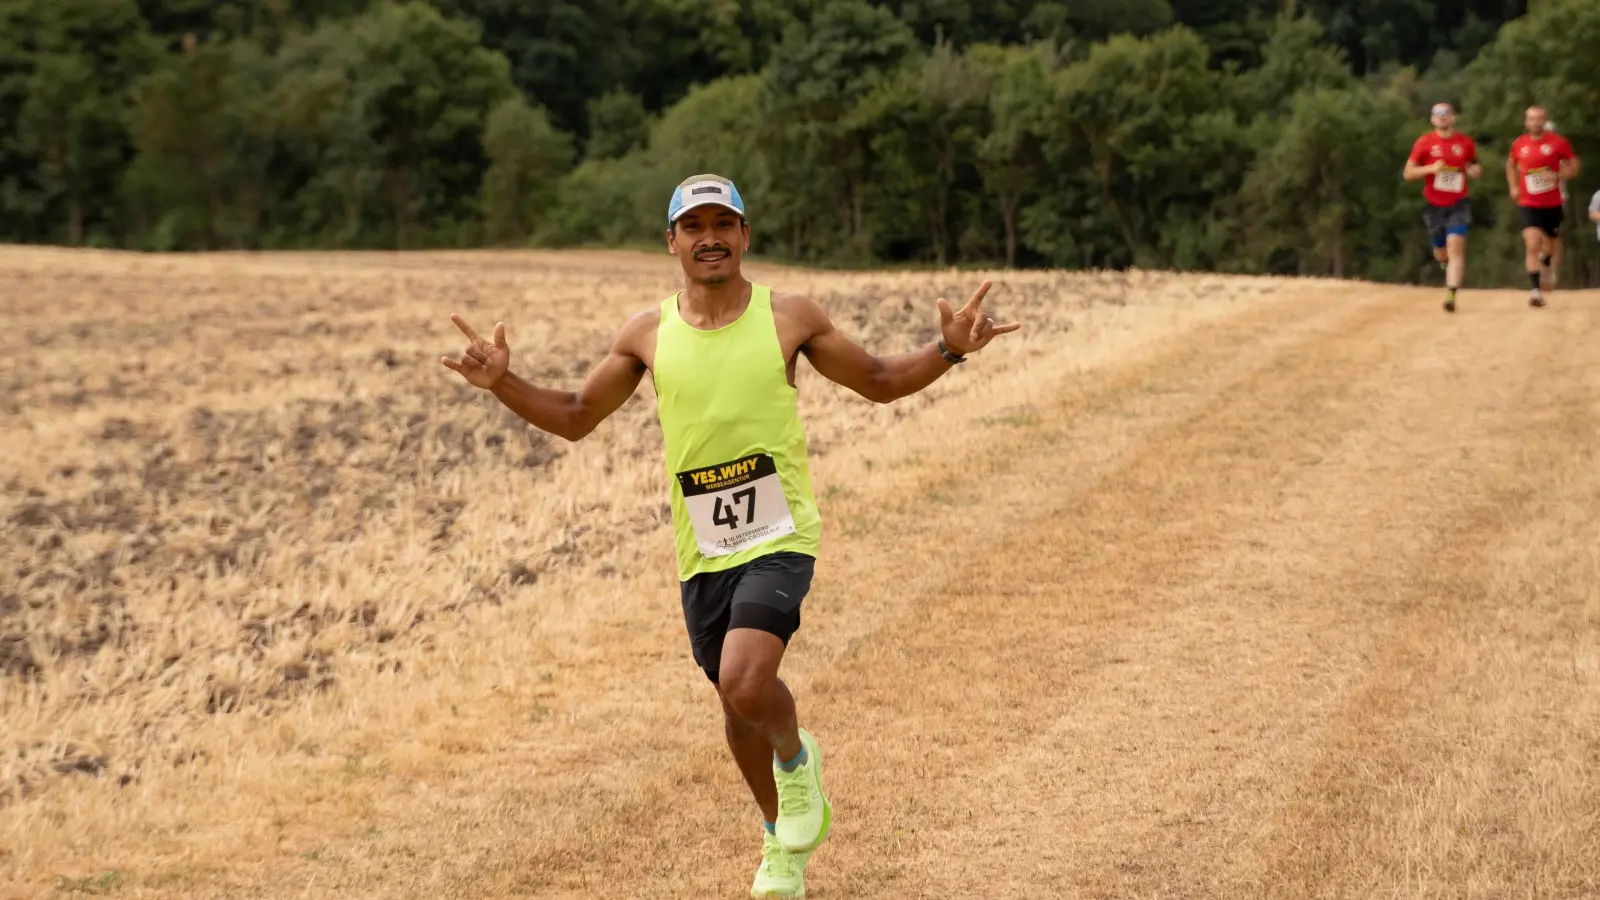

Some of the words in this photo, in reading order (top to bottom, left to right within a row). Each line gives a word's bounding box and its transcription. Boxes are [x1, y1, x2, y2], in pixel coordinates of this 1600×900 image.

[690, 457, 758, 485] YES.WHY
[705, 474, 750, 490] WERBEAGENTUR
[713, 486, 756, 529] 47
